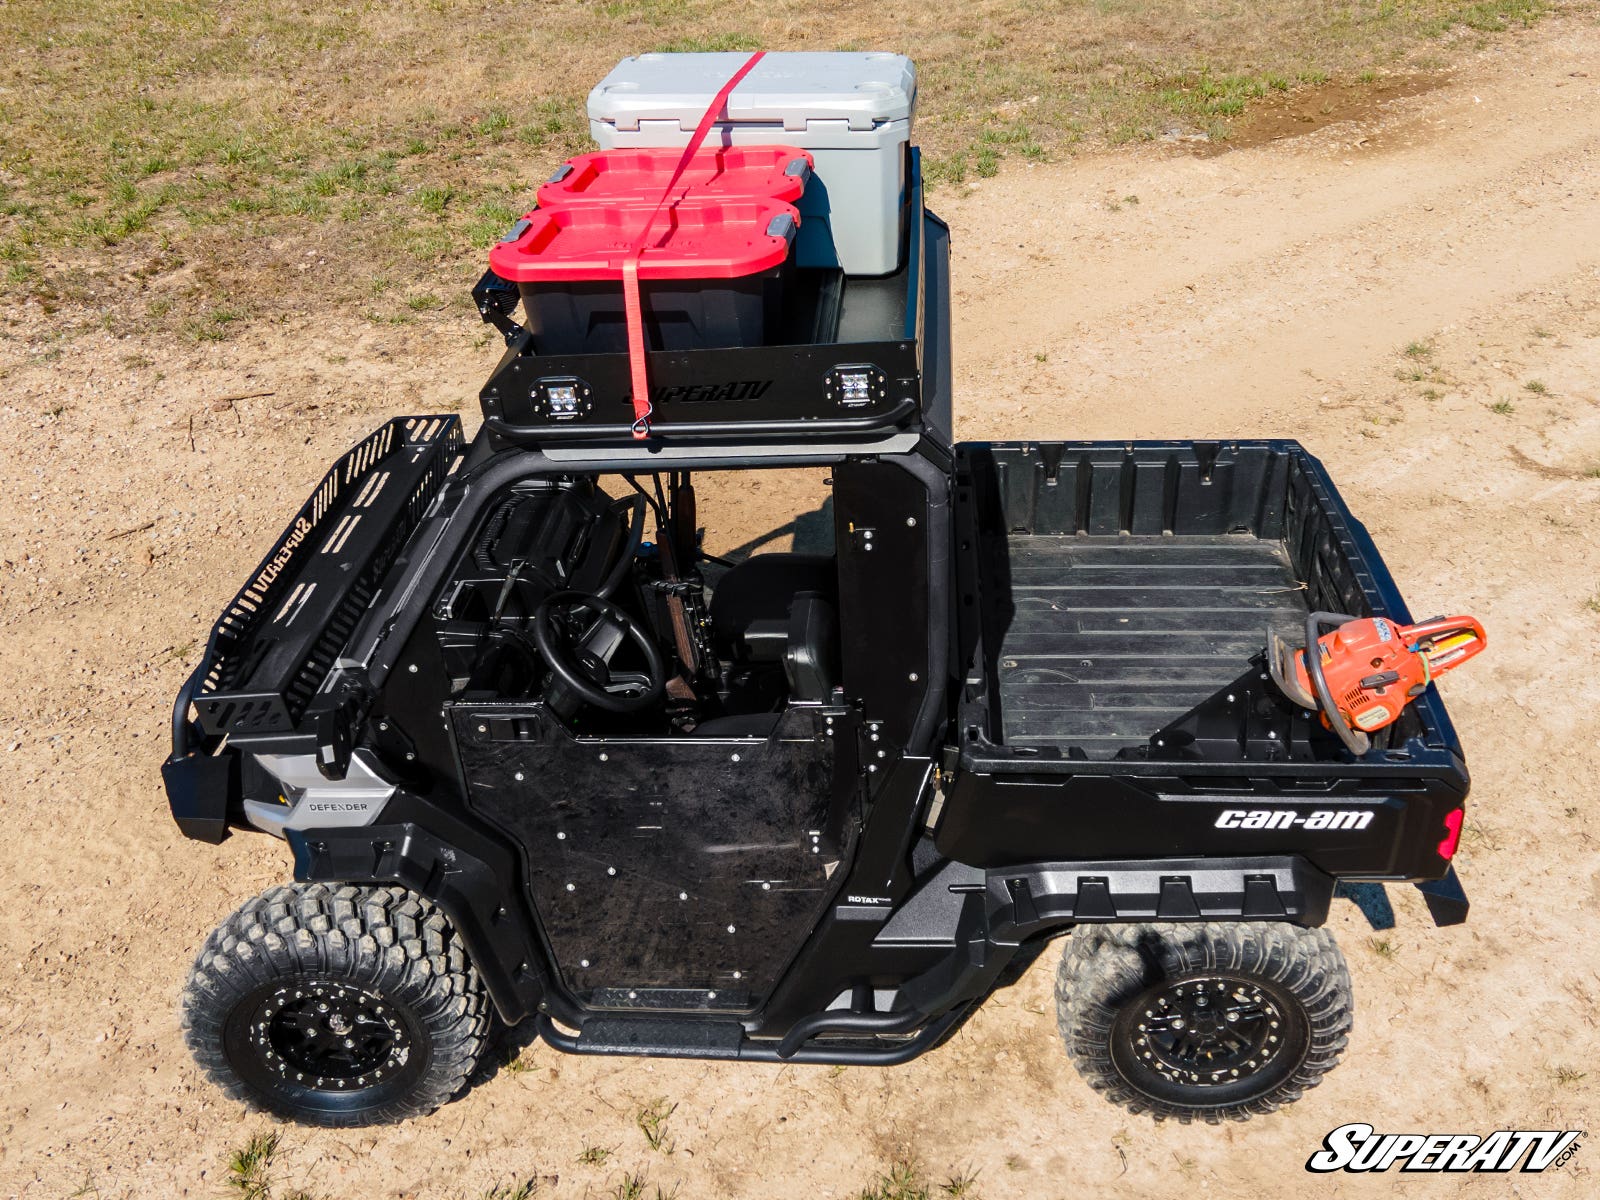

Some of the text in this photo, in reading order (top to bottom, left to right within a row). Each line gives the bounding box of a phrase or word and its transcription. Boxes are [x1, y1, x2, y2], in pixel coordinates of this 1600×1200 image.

[309, 803, 368, 812] DEFENDER
[1214, 810, 1375, 829] can-am
[847, 895, 879, 904] ROTAX
